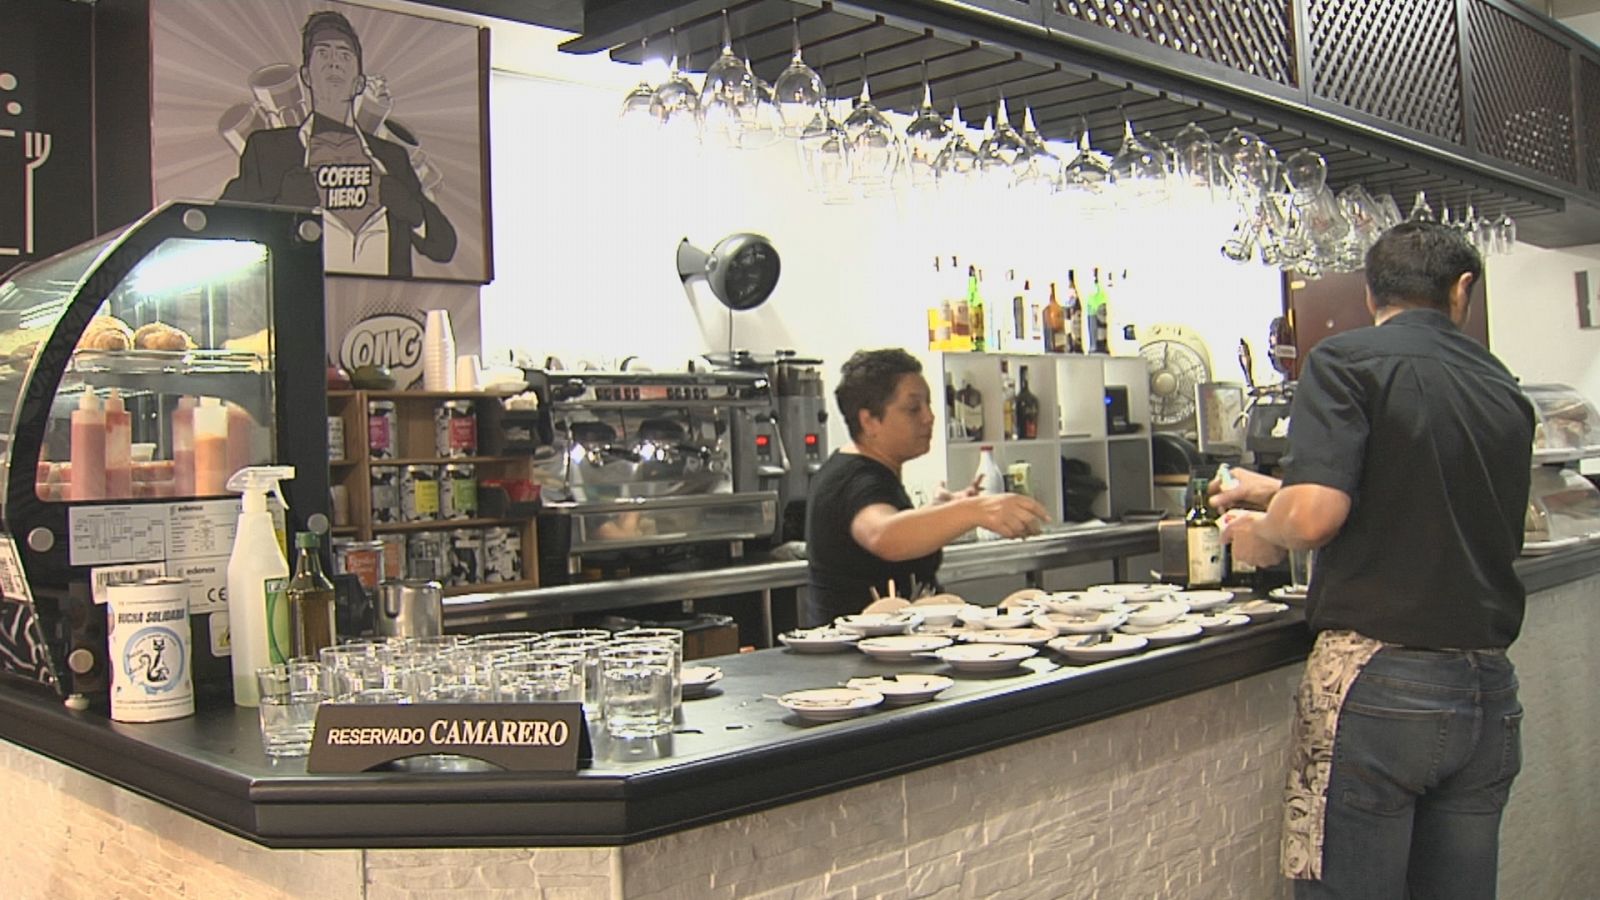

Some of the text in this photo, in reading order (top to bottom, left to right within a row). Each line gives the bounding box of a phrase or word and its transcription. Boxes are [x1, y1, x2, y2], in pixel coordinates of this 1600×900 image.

[318, 165, 371, 187] COFFEE
[328, 186, 367, 208] HERO
[351, 326, 422, 372] OMG
[327, 719, 568, 746] RESERVADO CAMARERO
